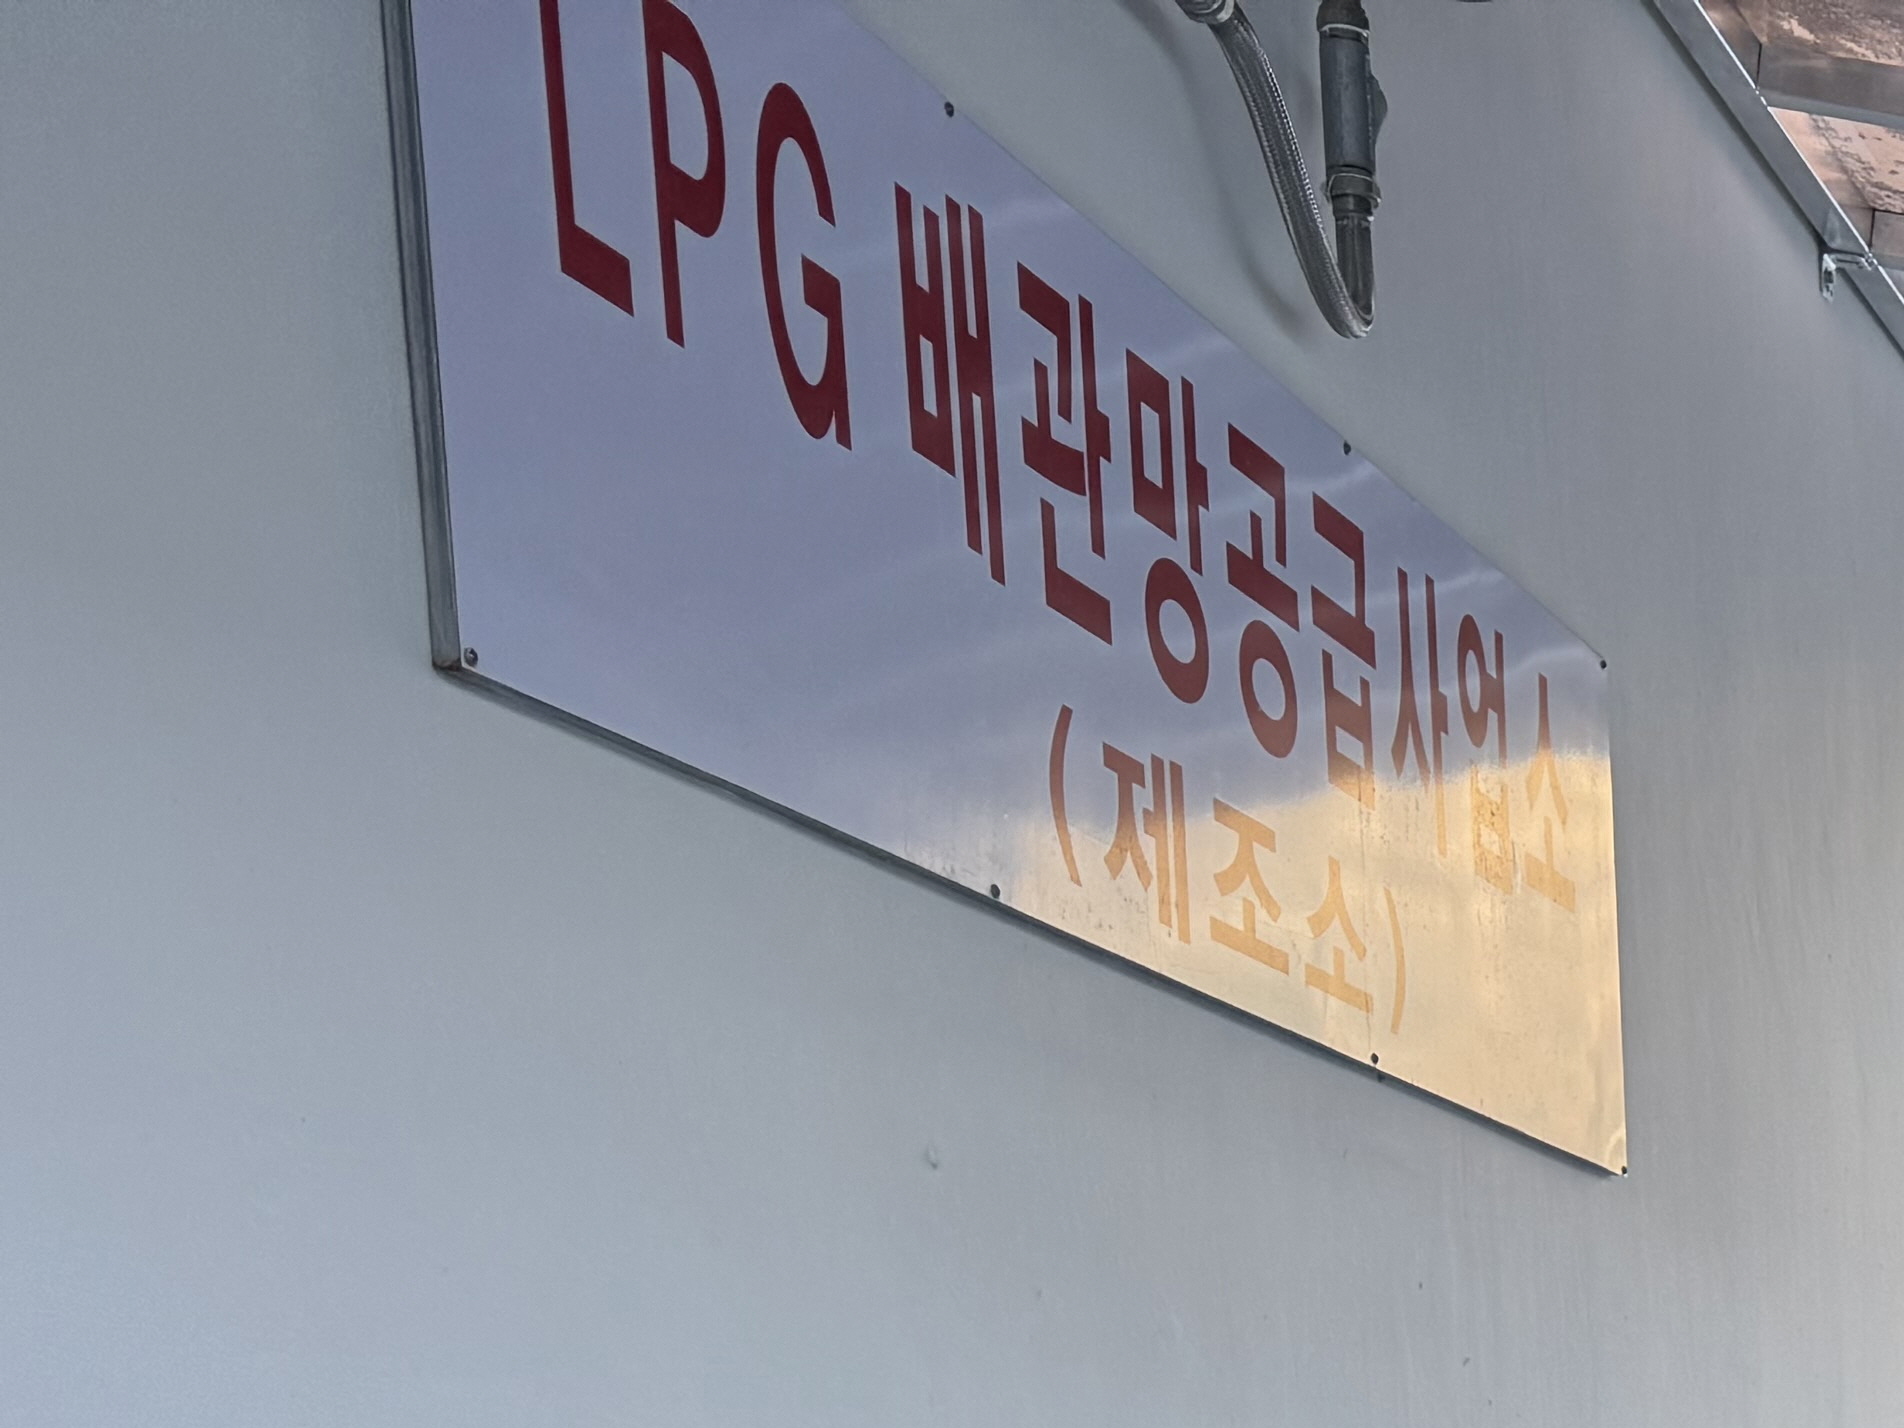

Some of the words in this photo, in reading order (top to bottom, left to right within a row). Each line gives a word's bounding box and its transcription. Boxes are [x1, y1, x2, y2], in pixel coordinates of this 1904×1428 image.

[540, 0, 852, 452] LPG
[893, 181, 1577, 913] 배관망공급사업소
[1048, 704, 1407, 1035] (제조소)
